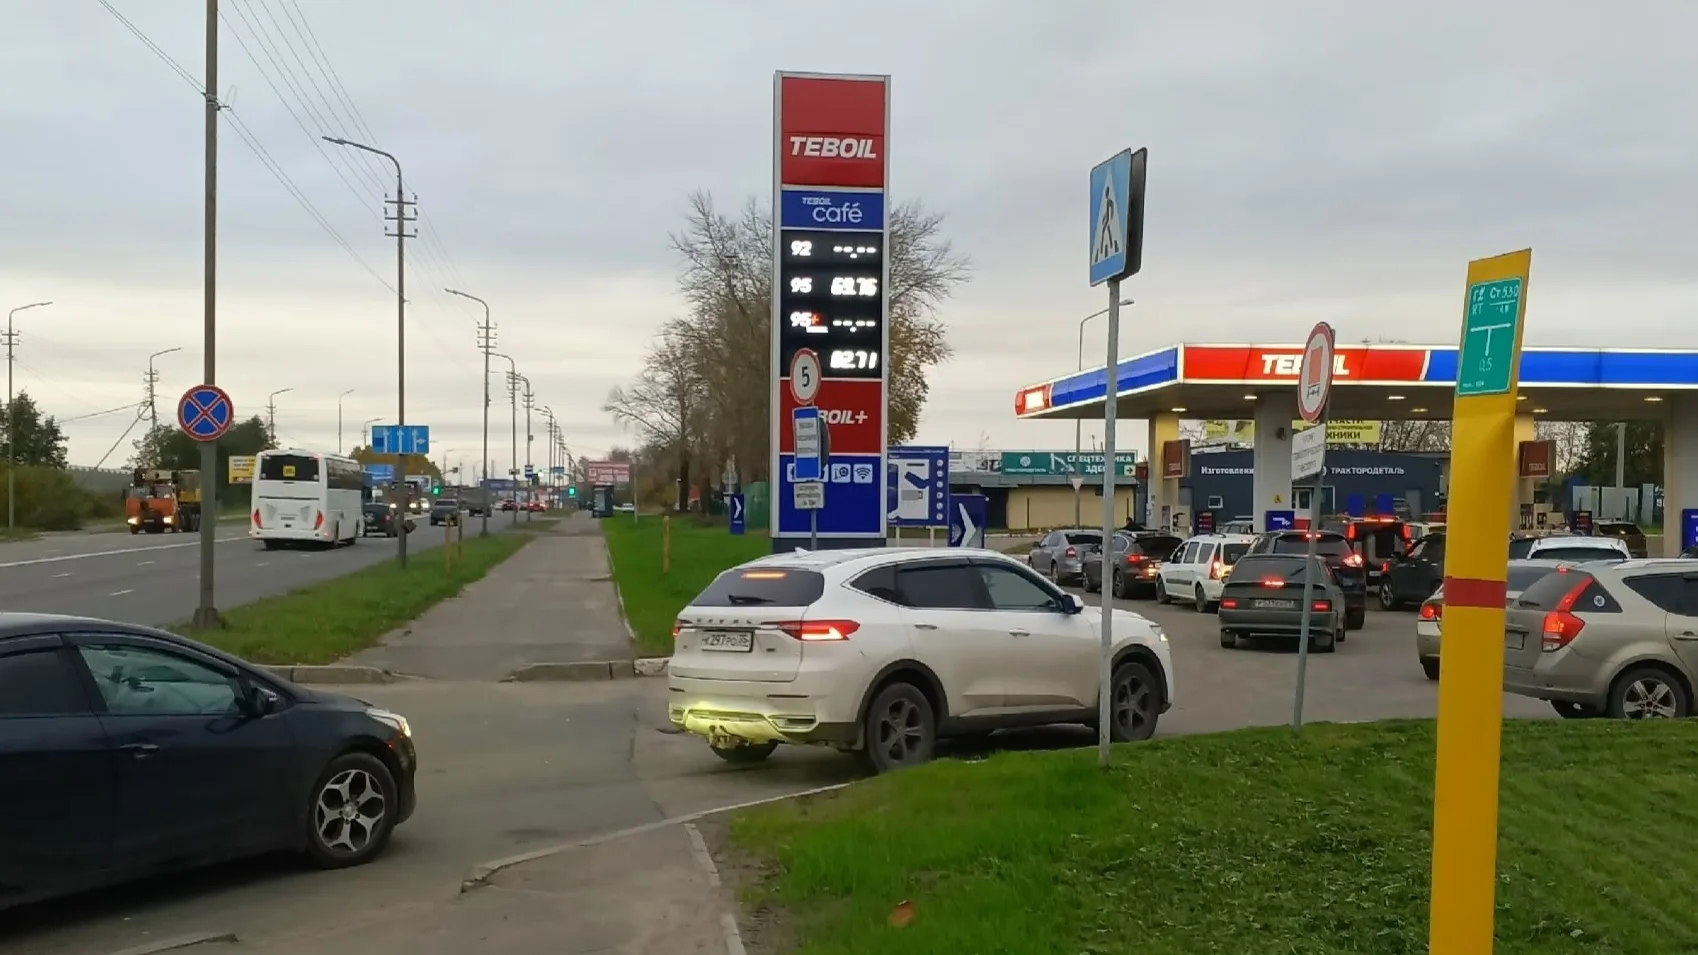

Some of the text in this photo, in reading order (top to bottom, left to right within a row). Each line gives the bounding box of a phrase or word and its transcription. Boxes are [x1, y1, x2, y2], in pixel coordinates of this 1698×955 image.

[790, 136, 877, 159] TEBOIL
[812, 202, 863, 223] café
[790, 240, 812, 256] 92
[790, 277, 812, 293] 95
[1261, 353, 1350, 376] TEIL
[801, 366, 810, 388] 5
[1327, 431, 1361, 440] ХНИКИ
[1067, 455, 1132, 463] СЕЦТЕХИКА
[1201, 466, 1405, 475] Изготовлени ТРАКТОРОДЕТАЛЬ
